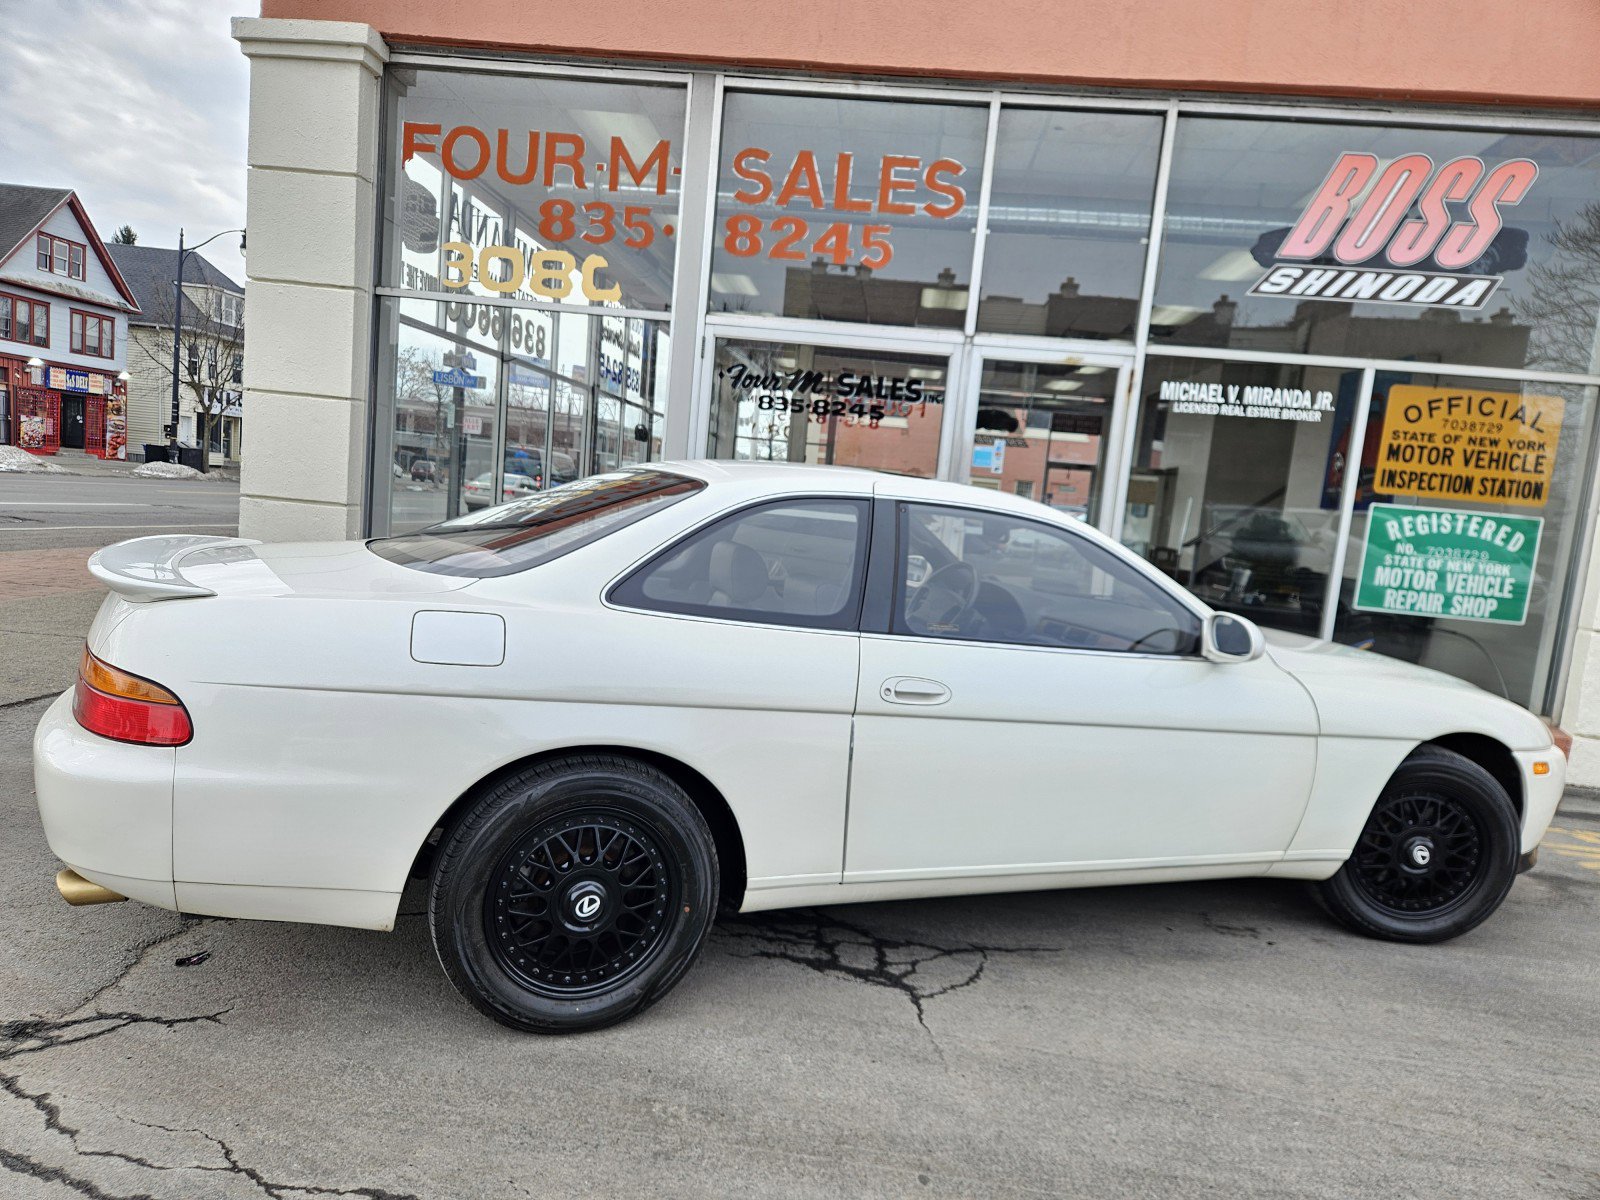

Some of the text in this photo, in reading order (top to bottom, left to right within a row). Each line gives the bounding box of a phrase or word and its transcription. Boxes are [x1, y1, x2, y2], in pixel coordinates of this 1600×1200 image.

[732, 147, 967, 219] SALES
[1275, 151, 1539, 269] BOSS
[724, 214, 894, 270] 8245
[1258, 267, 1491, 306] SHINODA
[435, 372, 465, 386] LISBON
[726, 364, 782, 390] Four
[785, 369, 824, 394] M
[837, 373, 925, 401] SALES
[1159, 380, 1225, 403] MICHAEL
[1242, 385, 1312, 409] MIRANDA
[1313, 390, 1335, 411] JR.
[1172, 402, 1322, 422] LICENSED REAL ESTATE BROKER
[1404, 395, 1545, 434] OFFICIAL
[1392, 430, 1546, 451] STATE OF NEW YORK
[1387, 443, 1547, 475] MOTOR VEHICLE
[1380, 469, 1545, 500] INSPECTION STATION
[1386, 513, 1525, 553] REGISTERED
[1373, 565, 1516, 599] MOTOR VEHICLE
[1384, 554, 1511, 577] STATE OF NEW YORK
[1383, 588, 1498, 618] REPAIR SHOP
